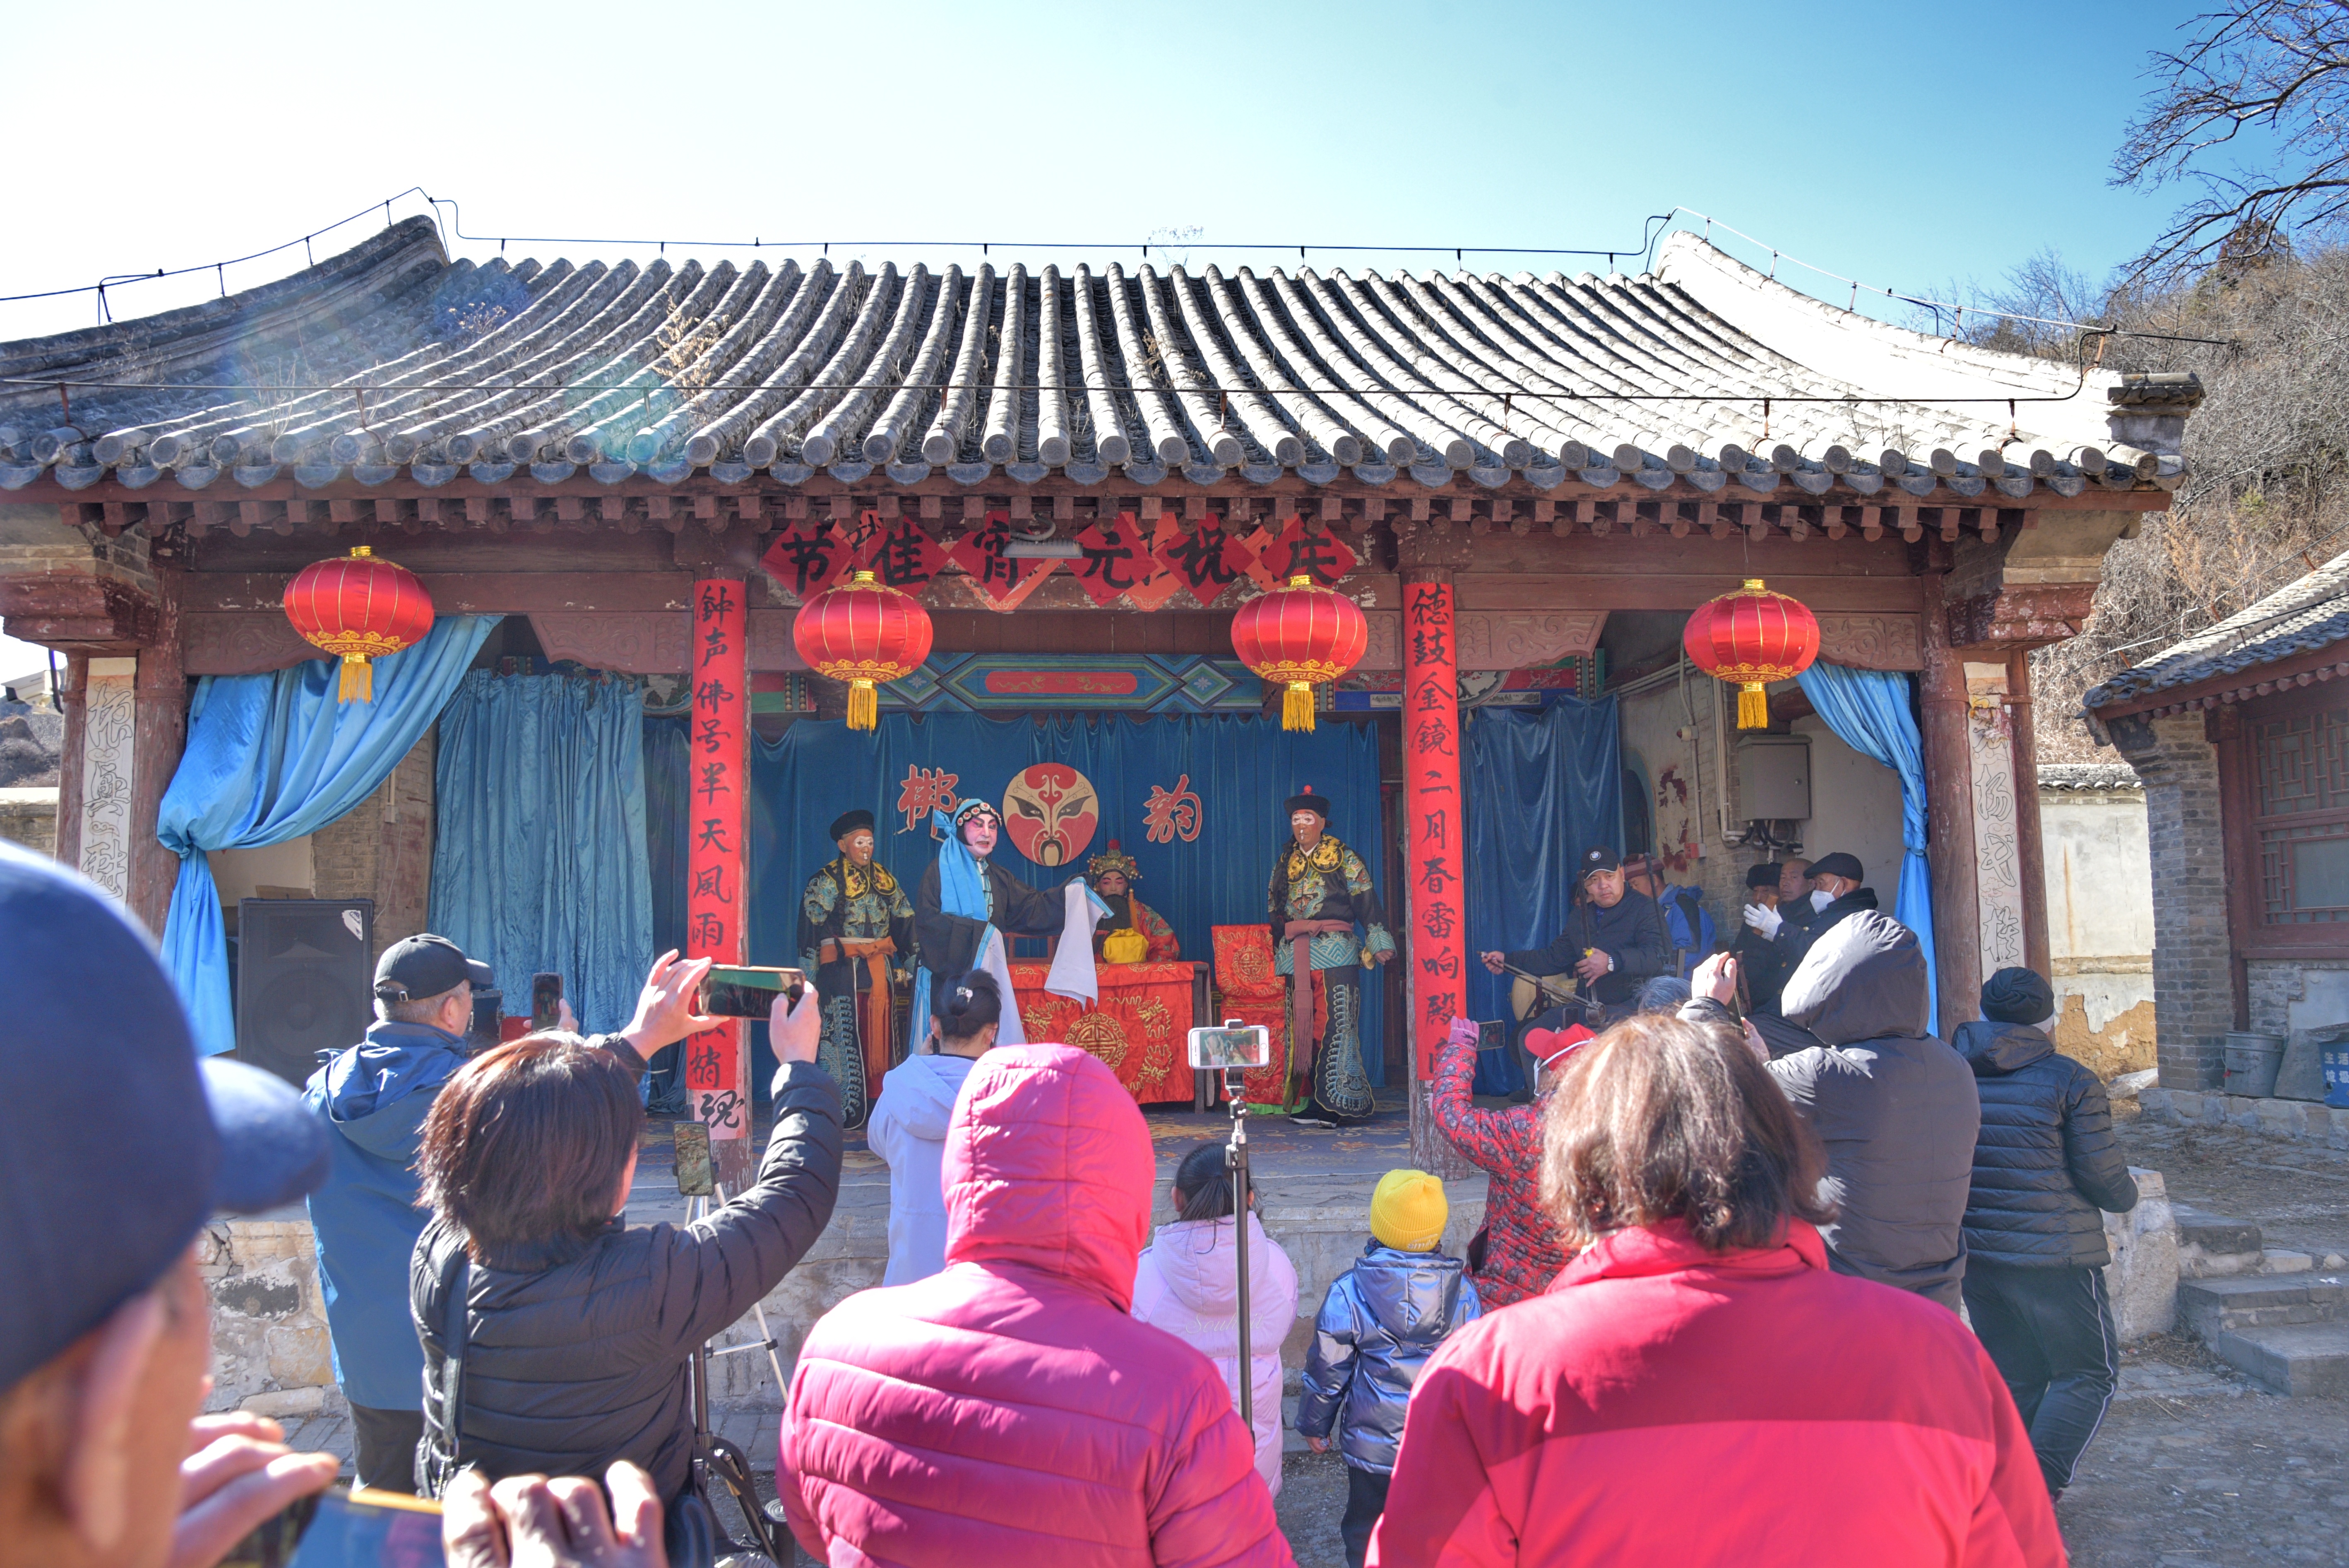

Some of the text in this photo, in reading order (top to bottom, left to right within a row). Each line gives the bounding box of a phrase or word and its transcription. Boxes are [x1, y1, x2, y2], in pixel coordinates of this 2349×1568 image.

[2325, 1052, 2349, 1065] 生活
[2326, 1070, 2349, 1083] 垃圾
[1185, 1312, 1265, 1334] Souhit
